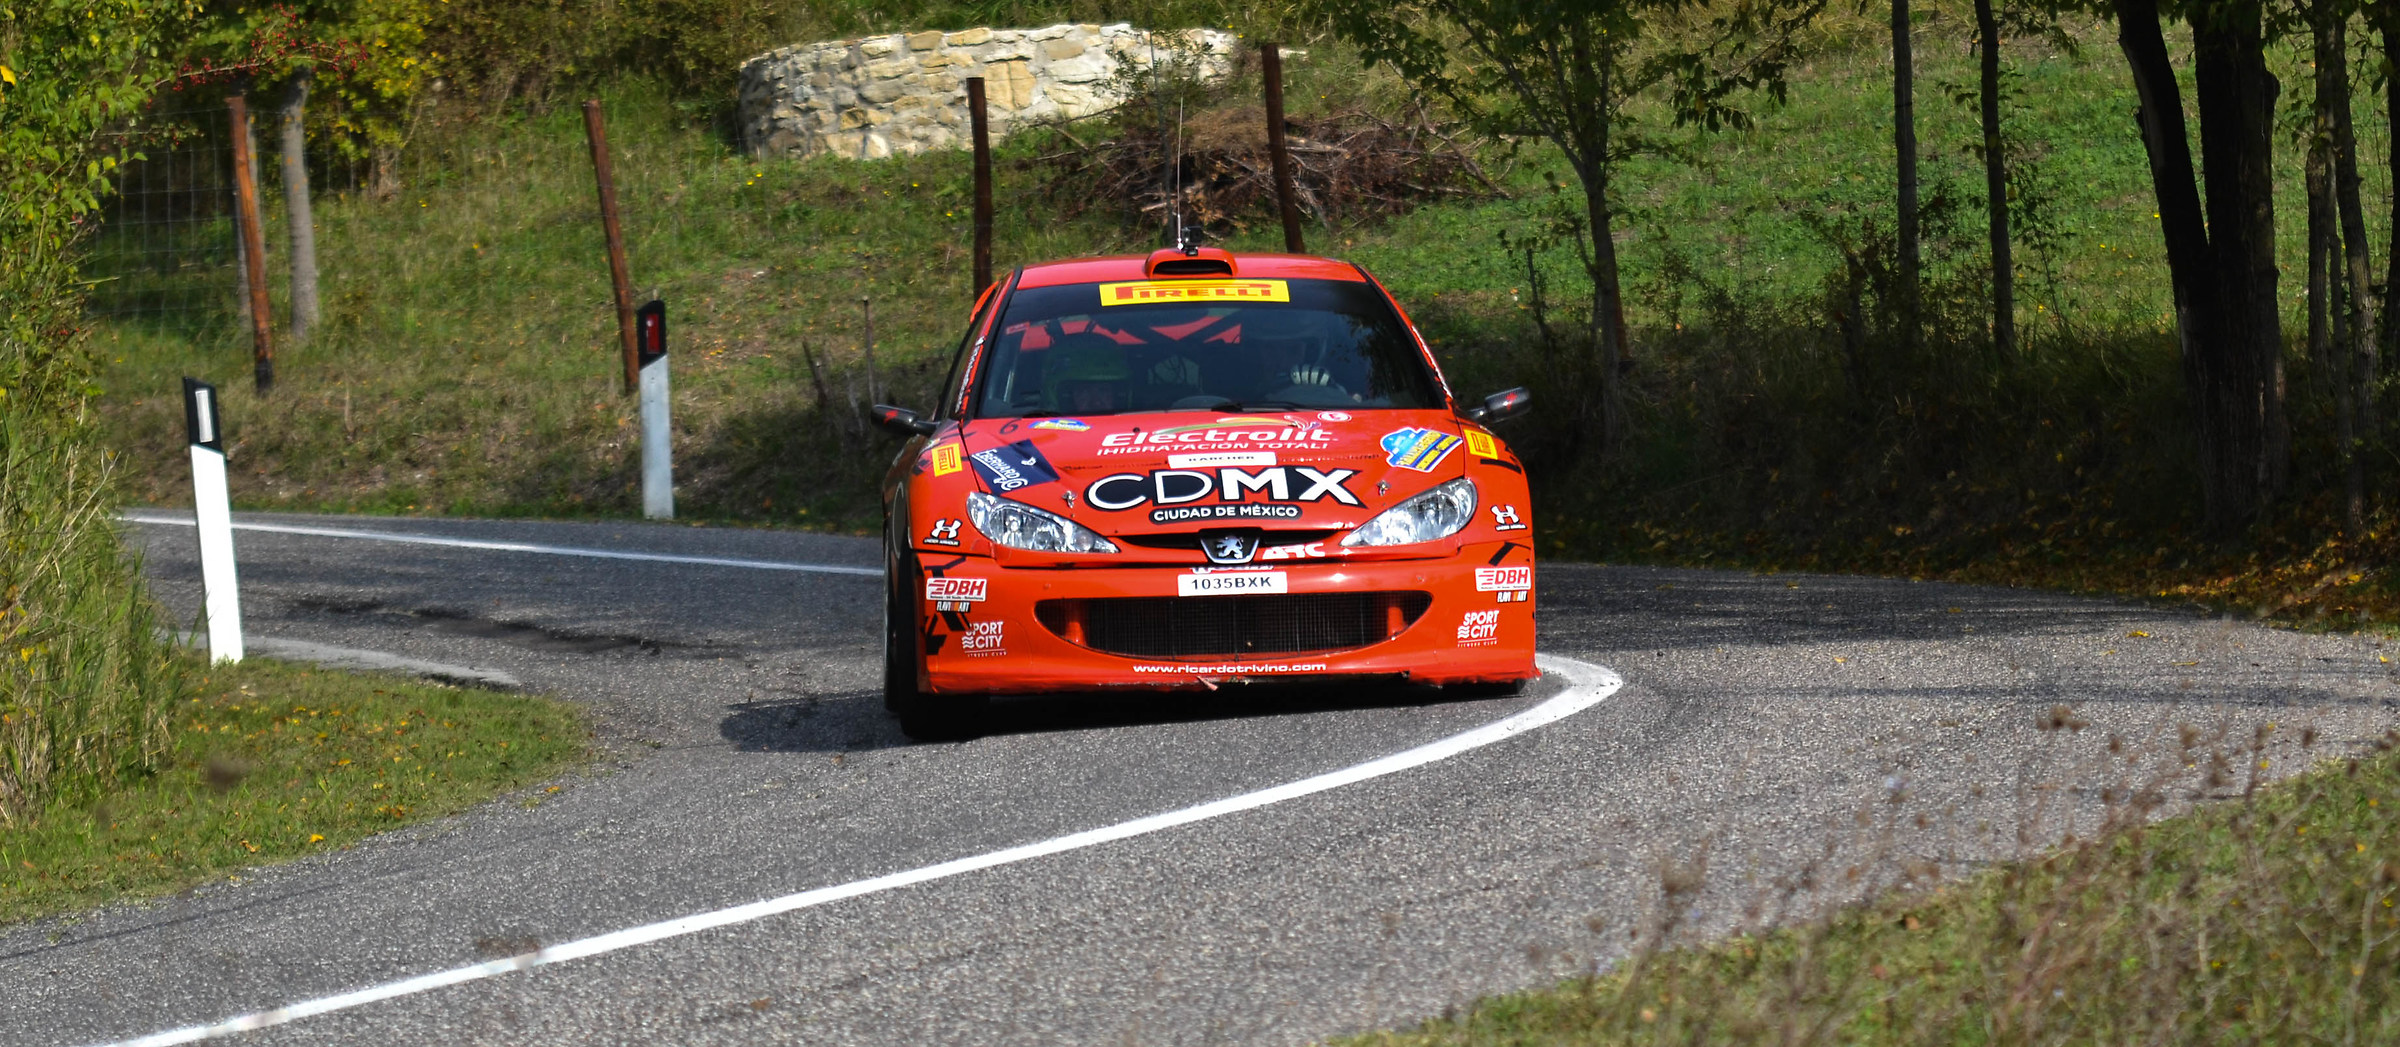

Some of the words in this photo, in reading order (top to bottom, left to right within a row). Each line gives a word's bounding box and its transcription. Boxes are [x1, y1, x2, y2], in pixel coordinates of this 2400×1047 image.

[1115, 283, 1272, 300] PIRELLI
[1101, 428, 1332, 447] Electrolit
[1087, 467, 1360, 509] CDMX
[1153, 506, 1212, 521] CIUDAD
[1215, 506, 1235, 517] DE
[1239, 504, 1298, 518] MÉXICO
[1191, 576, 1273, 591] 1035BXK
[1494, 569, 1529, 585] DBH
[944, 579, 985, 596] DBH
[1463, 610, 1500, 626] SPORT
[1470, 624, 1498, 638] CITY
[975, 635, 1004, 649] CITY
[1133, 663, 1327, 674] www.ricardotrivino.com
